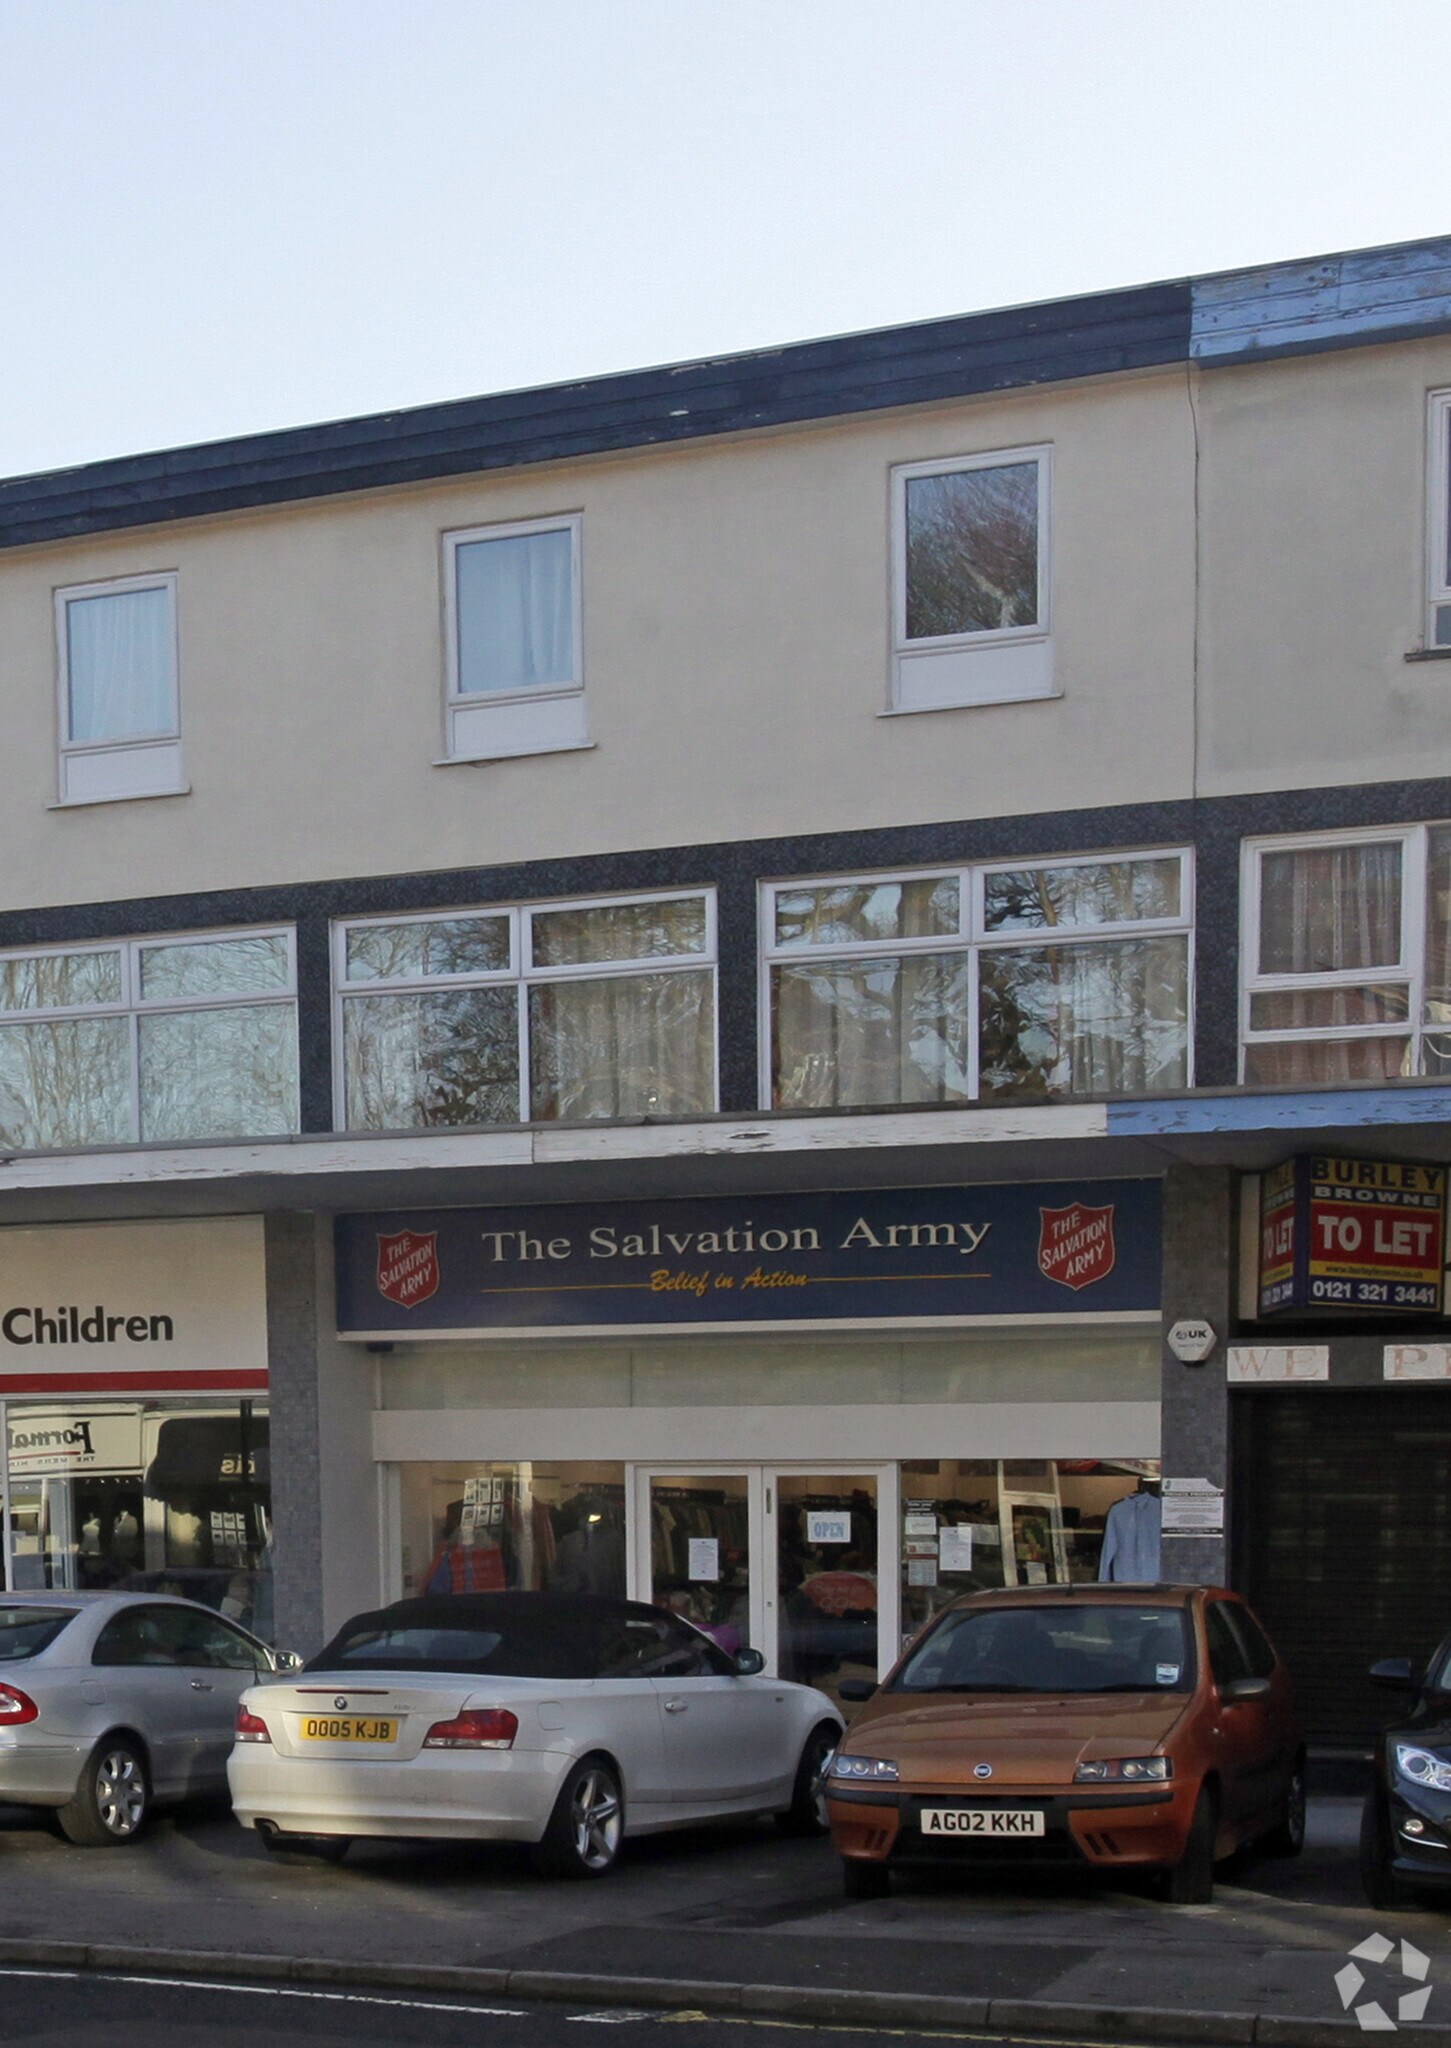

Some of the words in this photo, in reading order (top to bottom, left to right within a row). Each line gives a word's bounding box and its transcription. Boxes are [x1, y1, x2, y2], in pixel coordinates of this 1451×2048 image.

[1312, 1159, 1440, 1190] BURLEY
[1315, 1186, 1438, 1207] BROWNE
[481, 1230, 571, 1262] The
[589, 1221, 821, 1259] Salvation
[840, 1217, 992, 1253] Army
[1052, 1211, 1080, 1239] THE
[1276, 1216, 1294, 1255] LET
[1318, 1215, 1362, 1251] TO
[1374, 1220, 1433, 1256] LET
[387, 1237, 411, 1262] THE
[1042, 1214, 1106, 1270] SALVATION
[380, 1240, 433, 1290] SALVATION
[1066, 1240, 1105, 1279] ARMY
[400, 1263, 431, 1298] ARMY
[651, 1268, 709, 1297] Belief
[714, 1272, 735, 1289] in
[740, 1267, 808, 1290] Action
[1312, 1280, 1351, 1298] 0121
[1358, 1283, 1387, 1300] 321
[1394, 1286, 1435, 1304] 3441
[2, 1306, 173, 1345] Children
[1189, 1329, 1208, 1339] UK
[1231, 1348, 1319, 1378] WE
[814, 1522, 844, 1538] OPEN
[356, 1721, 389, 1738] KJB
[930, 1812, 985, 1831] AG02
[992, 1813, 1034, 1832] KKH
